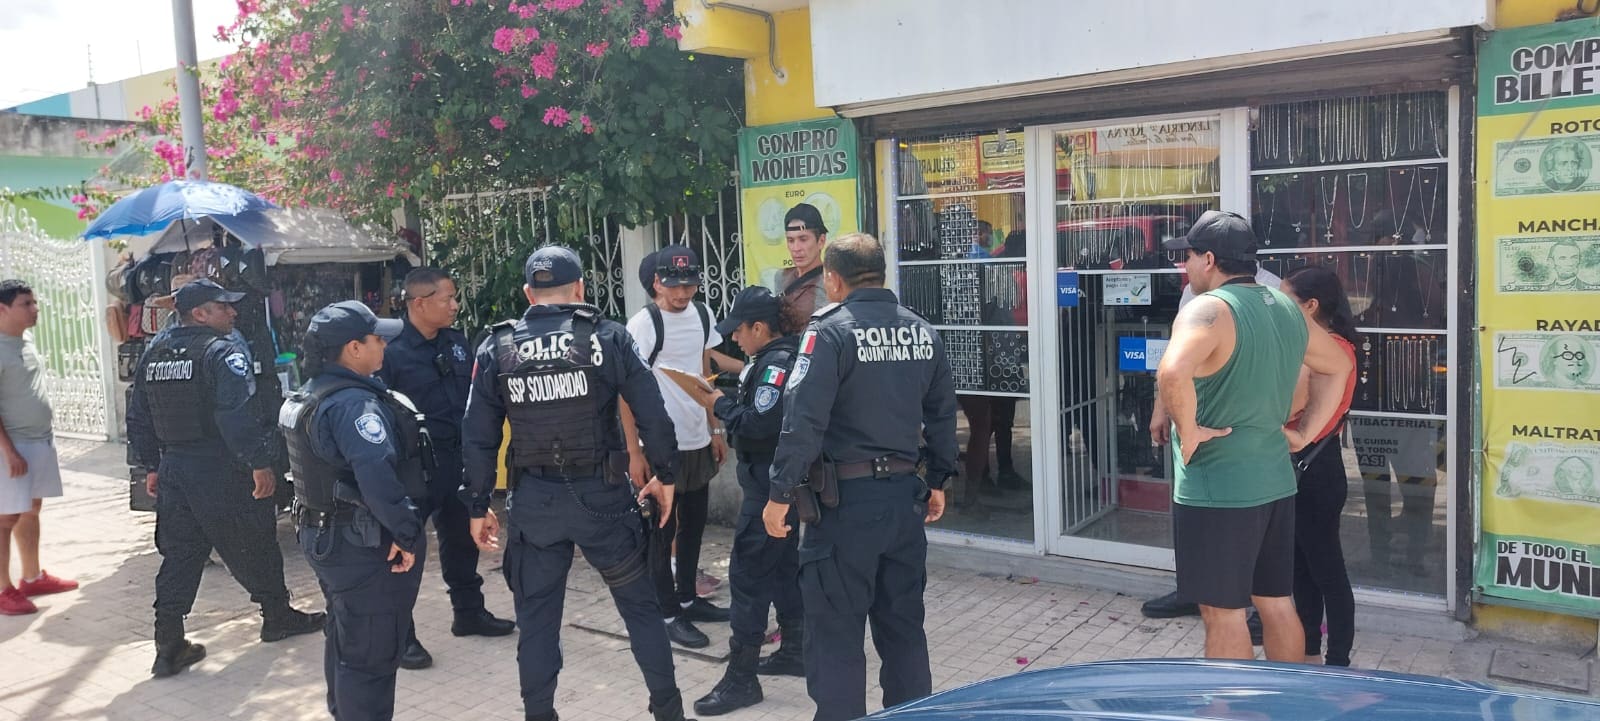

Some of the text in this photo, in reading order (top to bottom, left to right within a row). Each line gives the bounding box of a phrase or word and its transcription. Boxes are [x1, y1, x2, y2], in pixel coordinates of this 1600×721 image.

[1495, 66, 1600, 104] BILLE
[757, 128, 838, 157] COMPRO
[752, 151, 848, 183] MONEDAS
[785, 190, 805, 198] EURO
[1518, 218, 1600, 233] MANCH
[518, 333, 603, 358] OLICA
[852, 325, 933, 346] POLICÍA
[857, 346, 911, 362] QUINTANA
[1123, 351, 1145, 359] VISA
[508, 370, 588, 403] SSP SOLIDARIDAD
[1358, 454, 1386, 467] AS!
[1497, 541, 1591, 564] DE TODO EL
